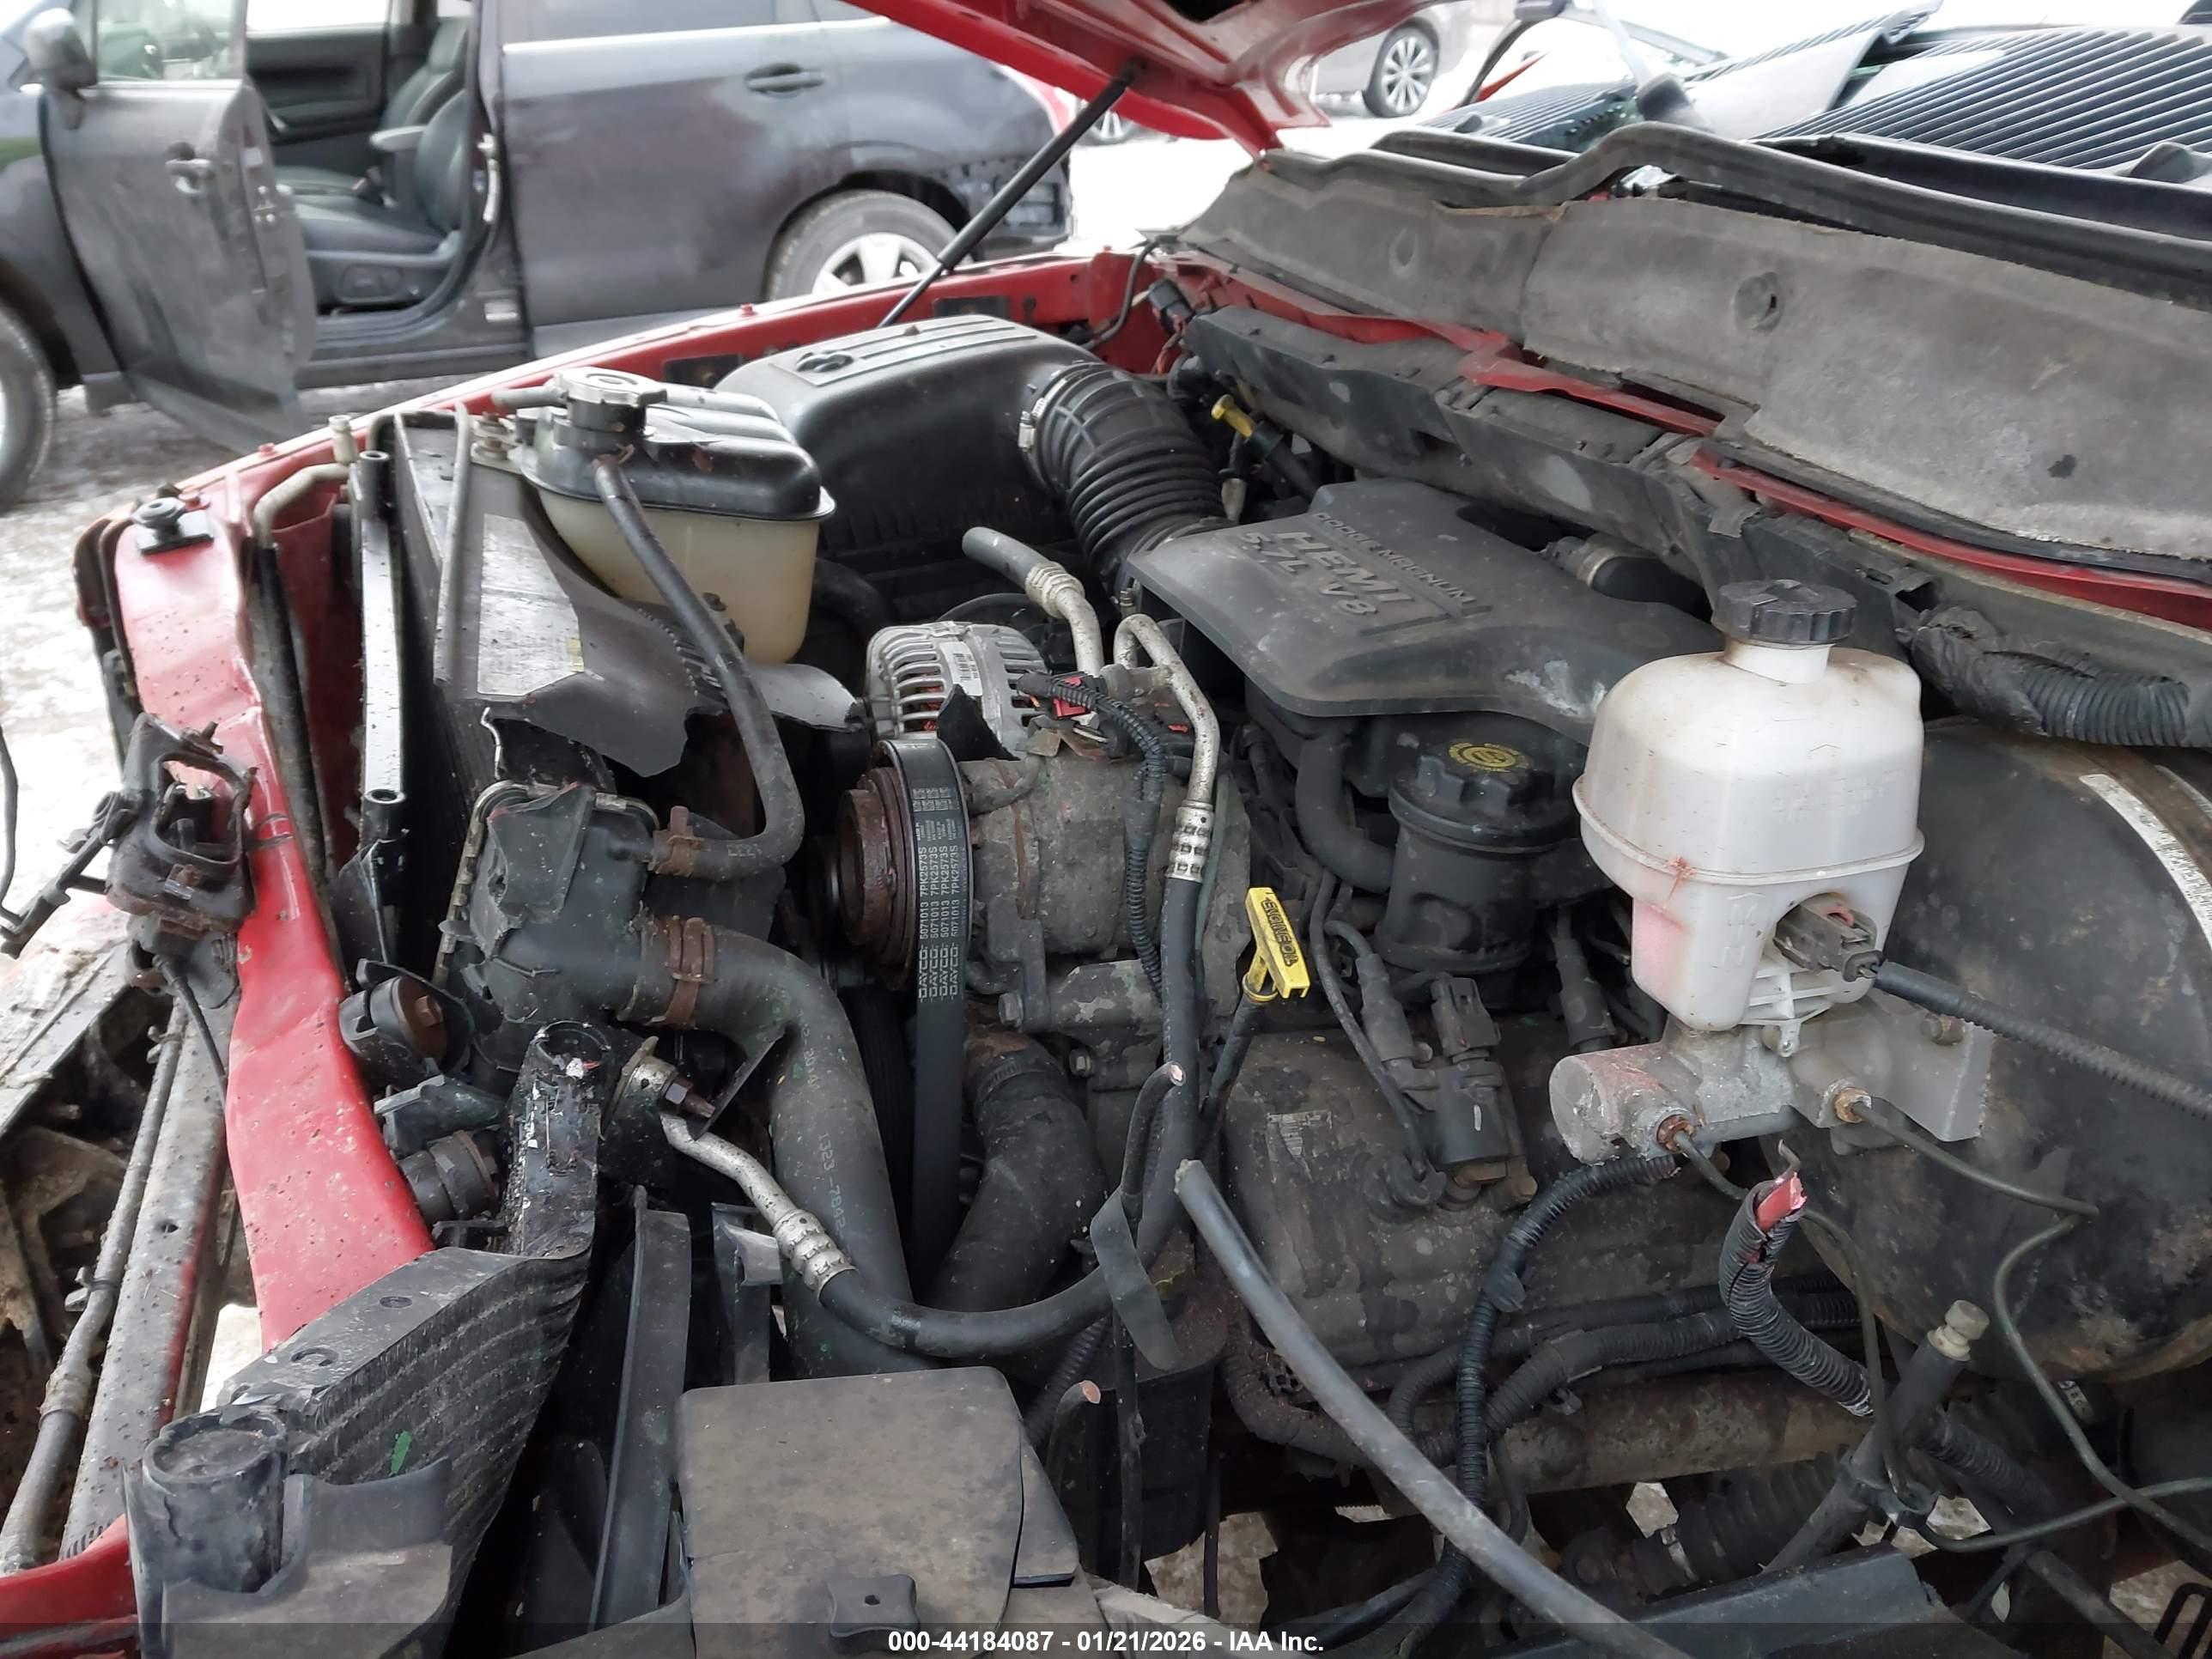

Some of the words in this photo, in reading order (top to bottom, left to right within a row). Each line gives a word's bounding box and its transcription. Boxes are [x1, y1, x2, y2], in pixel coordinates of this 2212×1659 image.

[1237, 532, 1310, 575] 5.7L
[1320, 581, 1378, 615] V8
[1272, 532, 1416, 603] HEMI
[1376, 550, 1478, 604] MAGNUM
[919, 847, 929, 897] 7PK2573S
[929, 846, 939, 896] 7PK2573S
[939, 845, 950, 896] 7PK2573S
[950, 844, 960, 895] 7PK2573S
[920, 901, 929, 939] 5071013
[930, 900, 939, 939] 5071013
[940, 899, 950, 938] 5071013
[1261, 899, 1292, 944] ENGINE
[1280, 944, 1299, 967] OIL
[918, 947, 928, 1000] DAYCO
[928, 946, 939, 1000] DAYCO
[939, 945, 949, 999] DAYCO
[949, 945, 959, 998] DAYCO
[818, 1133, 836, 1171] 1323
